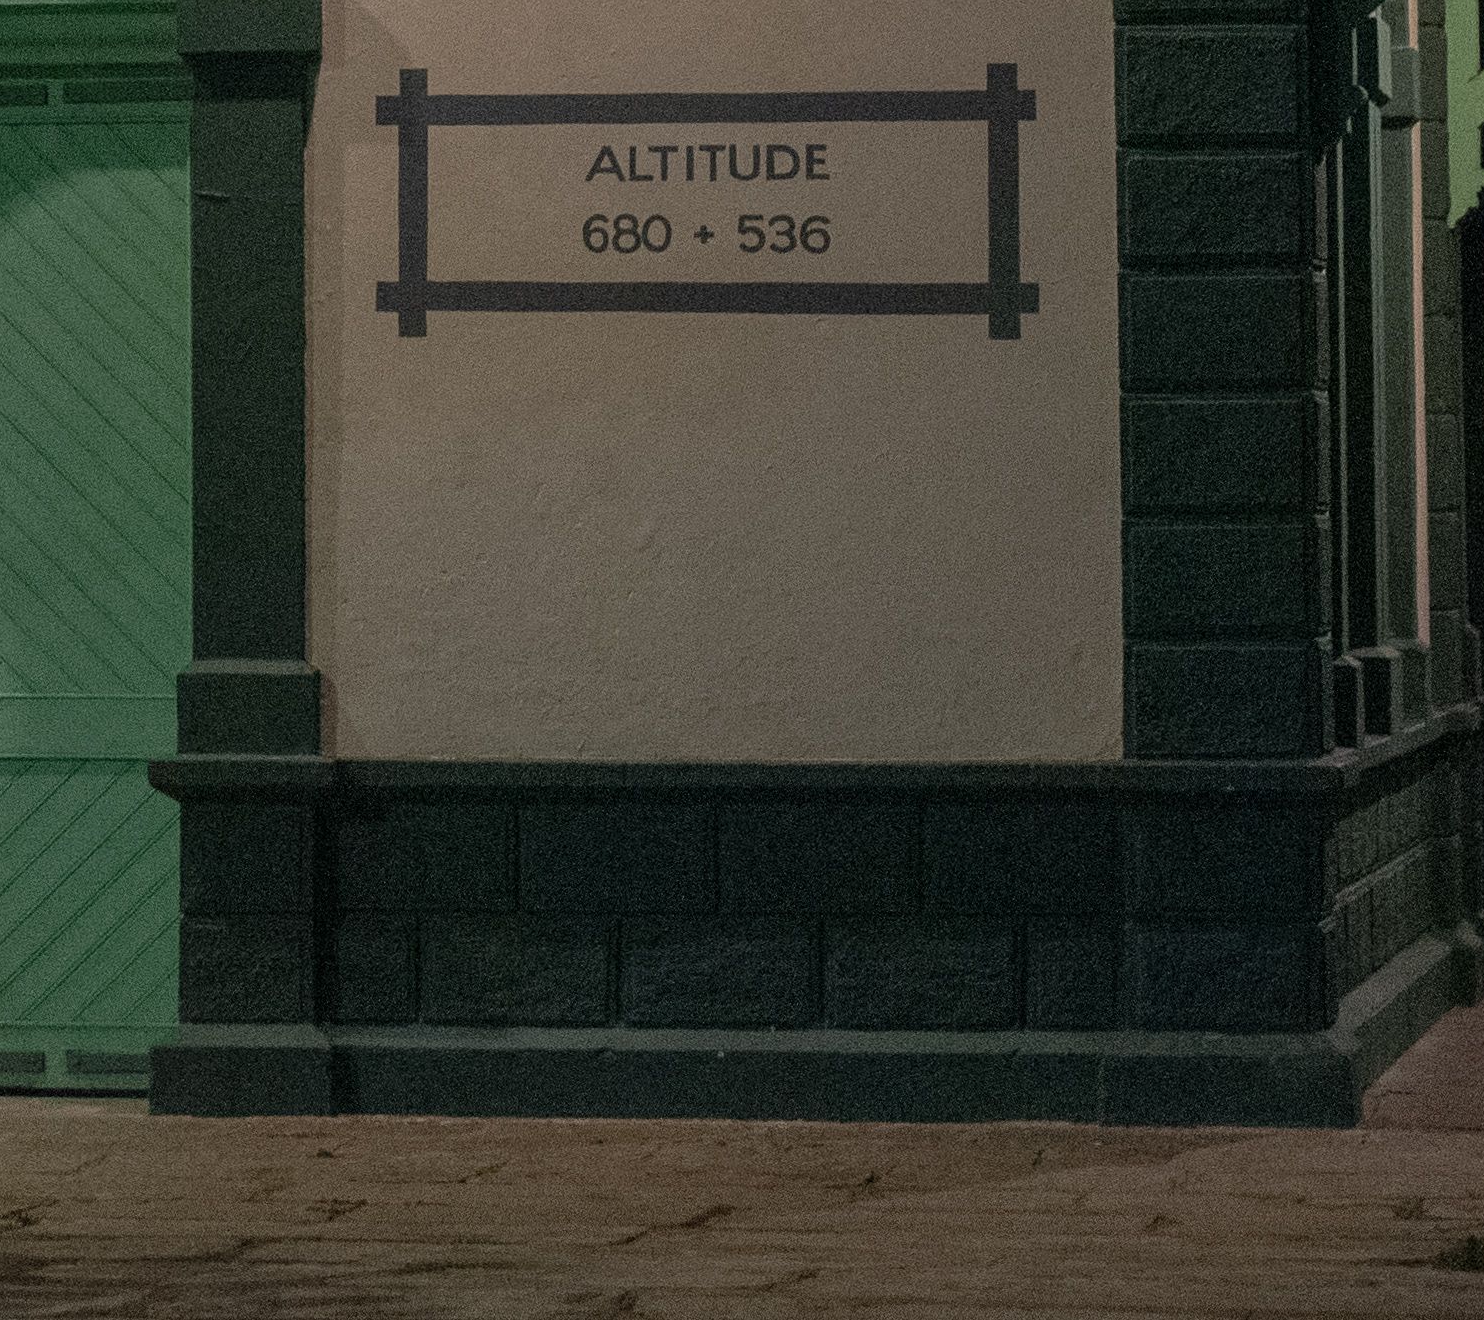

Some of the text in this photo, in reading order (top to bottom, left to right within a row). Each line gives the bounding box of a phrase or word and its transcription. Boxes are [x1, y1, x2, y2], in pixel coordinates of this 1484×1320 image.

[585, 144, 831, 183] ALTITUDE
[582, 213, 831, 255] 680 + 536
